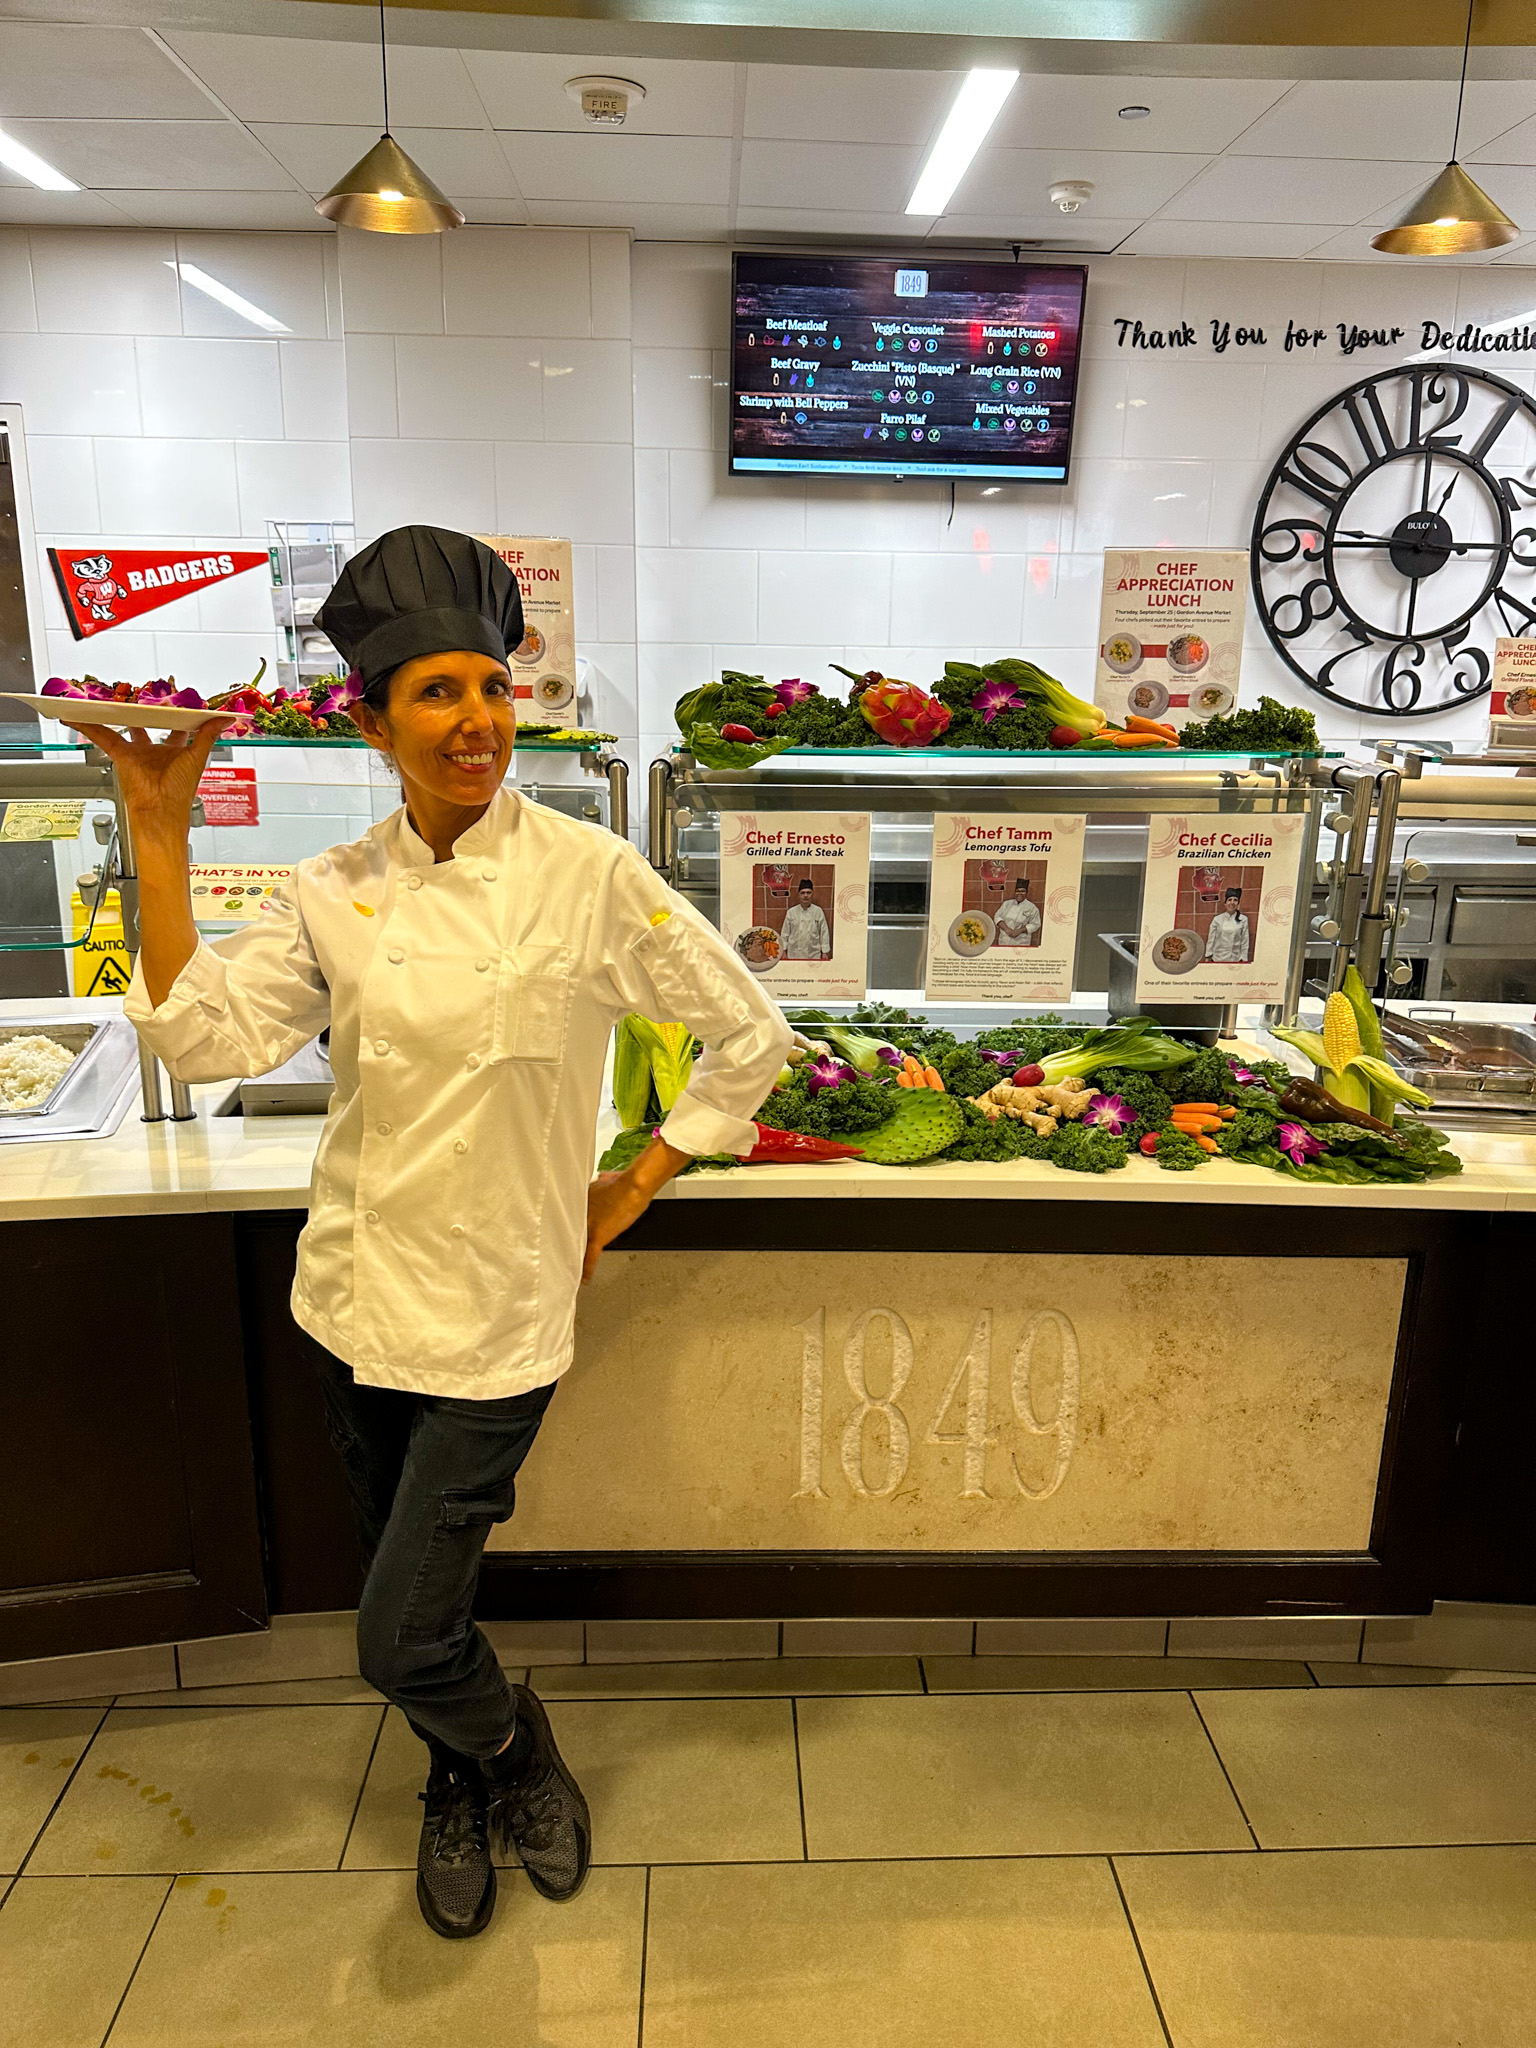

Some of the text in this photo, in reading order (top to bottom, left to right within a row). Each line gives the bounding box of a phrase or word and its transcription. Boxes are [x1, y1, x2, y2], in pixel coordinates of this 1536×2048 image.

[592, 100, 617, 108] FIRE
[902, 275, 922, 292] 1849
[766, 318, 828, 332] Beef Meatloaf
[872, 322, 944, 336] Veggie Cassoulet
[982, 326, 1056, 339] Mashed Potatoes
[1114, 318, 1197, 349] Thank
[1210, 320, 1267, 353] You
[1284, 320, 1327, 352] for
[1336, 323, 1404, 354] Your
[771, 358, 820, 372] Beef Gravy
[852, 360, 890, 372] Zucchini
[918, 362, 954, 376] (Basque)
[970, 364, 993, 378] Long
[994, 365, 1019, 376] Grain
[1020, 366, 1040, 377] Rice
[1040, 366, 1062, 380] (VN)
[895, 374, 916, 388] (VN)
[740, 396, 848, 411] Shrimp with Bell Peppers
[975, 403, 1050, 417] Mixed Vegetables
[1408, 370, 1470, 448] 12
[880, 412, 926, 424] Farro Pilaf
[1280, 442, 1354, 510] 10
[1260, 518, 1326, 563] 9
[496, 550, 524, 564] HEF
[127, 554, 234, 592] BADGERS
[1156, 562, 1198, 576] CHEF
[100, 582, 112, 598] W
[1117, 578, 1234, 592] APPRECIATION
[1148, 594, 1201, 607] LUNCH
[1269, 578, 1338, 639] 8
[1316, 621, 1374, 688] 7
[1442, 619, 1490, 693] 5
[1382, 642, 1425, 711] 6
[746, 831, 845, 845] Chef Ernesto
[966, 826, 1052, 840] Chef Tamm
[1178, 833, 1272, 846] Chef Cecilia
[746, 847, 844, 856] Grilled Flank Steak
[965, 842, 1052, 853] Lemongrass Tofu
[1177, 849, 1271, 859] Brazilian Chicken
[83, 940, 125, 952] CAUTIO
[790, 1306, 1081, 1500] 1849
